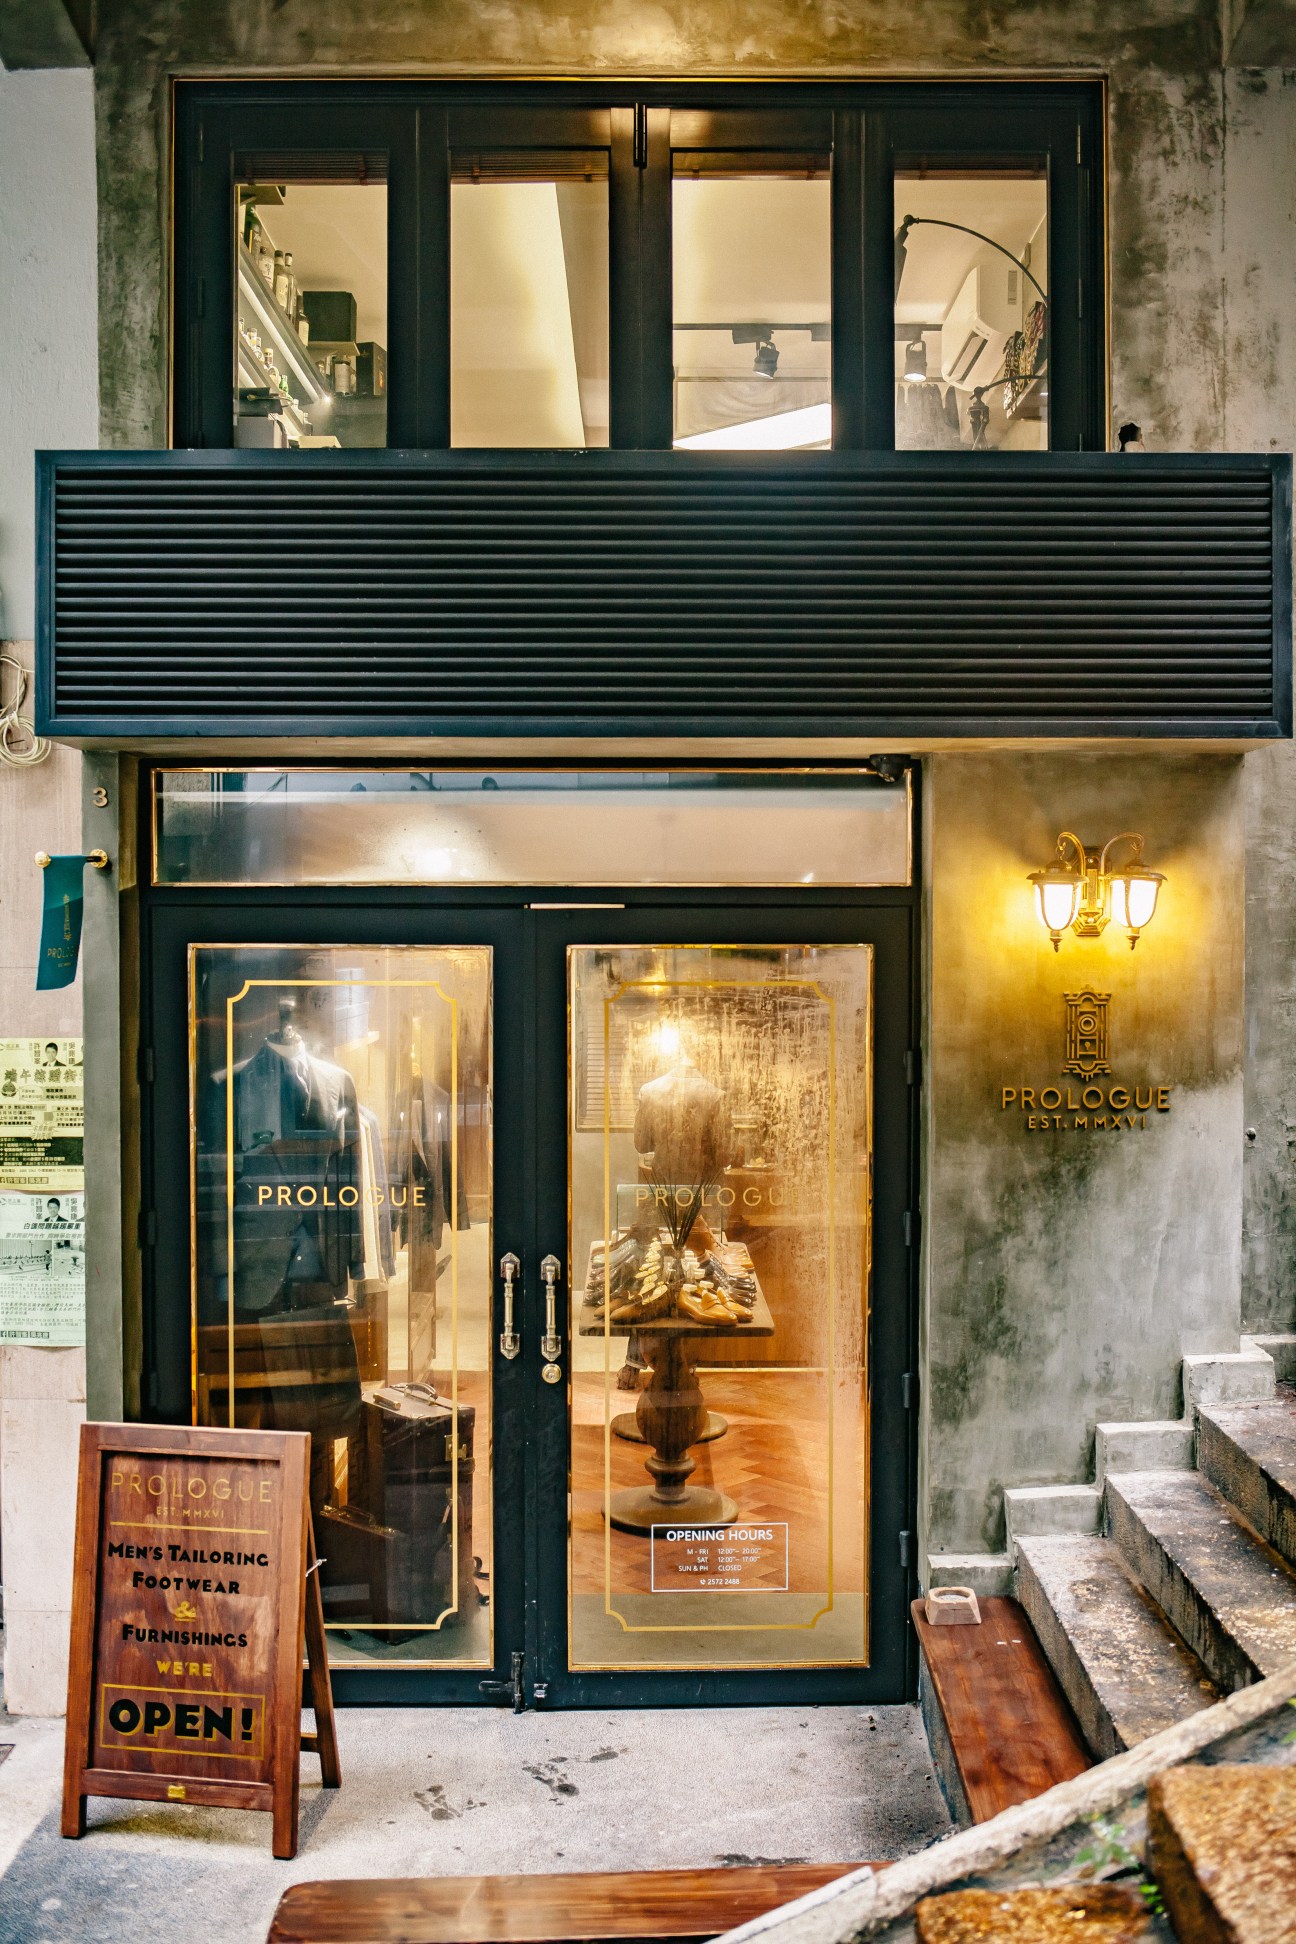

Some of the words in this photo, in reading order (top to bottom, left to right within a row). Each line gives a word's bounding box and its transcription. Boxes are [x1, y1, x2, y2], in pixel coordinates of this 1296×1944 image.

[93, 786, 108, 807] 3
[1002, 1086, 1172, 1109] PROLOGUE
[1028, 1115, 1067, 1129] EST.
[1074, 1115, 1147, 1129] MMXVI
[258, 1185, 426, 1207] PROLOGUE
[110, 1472, 273, 1503] PROLOGUE
[182, 1509, 224, 1519] MMXVI
[666, 1530, 725, 1542] OPENING
[728, 1529, 773, 1541] HOURS
[168, 1545, 269, 1567] TAILORING
[132, 1571, 240, 1594] FOOTWEAR
[174, 1600, 197, 1618] &
[122, 1624, 248, 1647] FURNISHINGS
[156, 1660, 213, 1677] WE'RE
[108, 1698, 255, 1743] OPEN!
